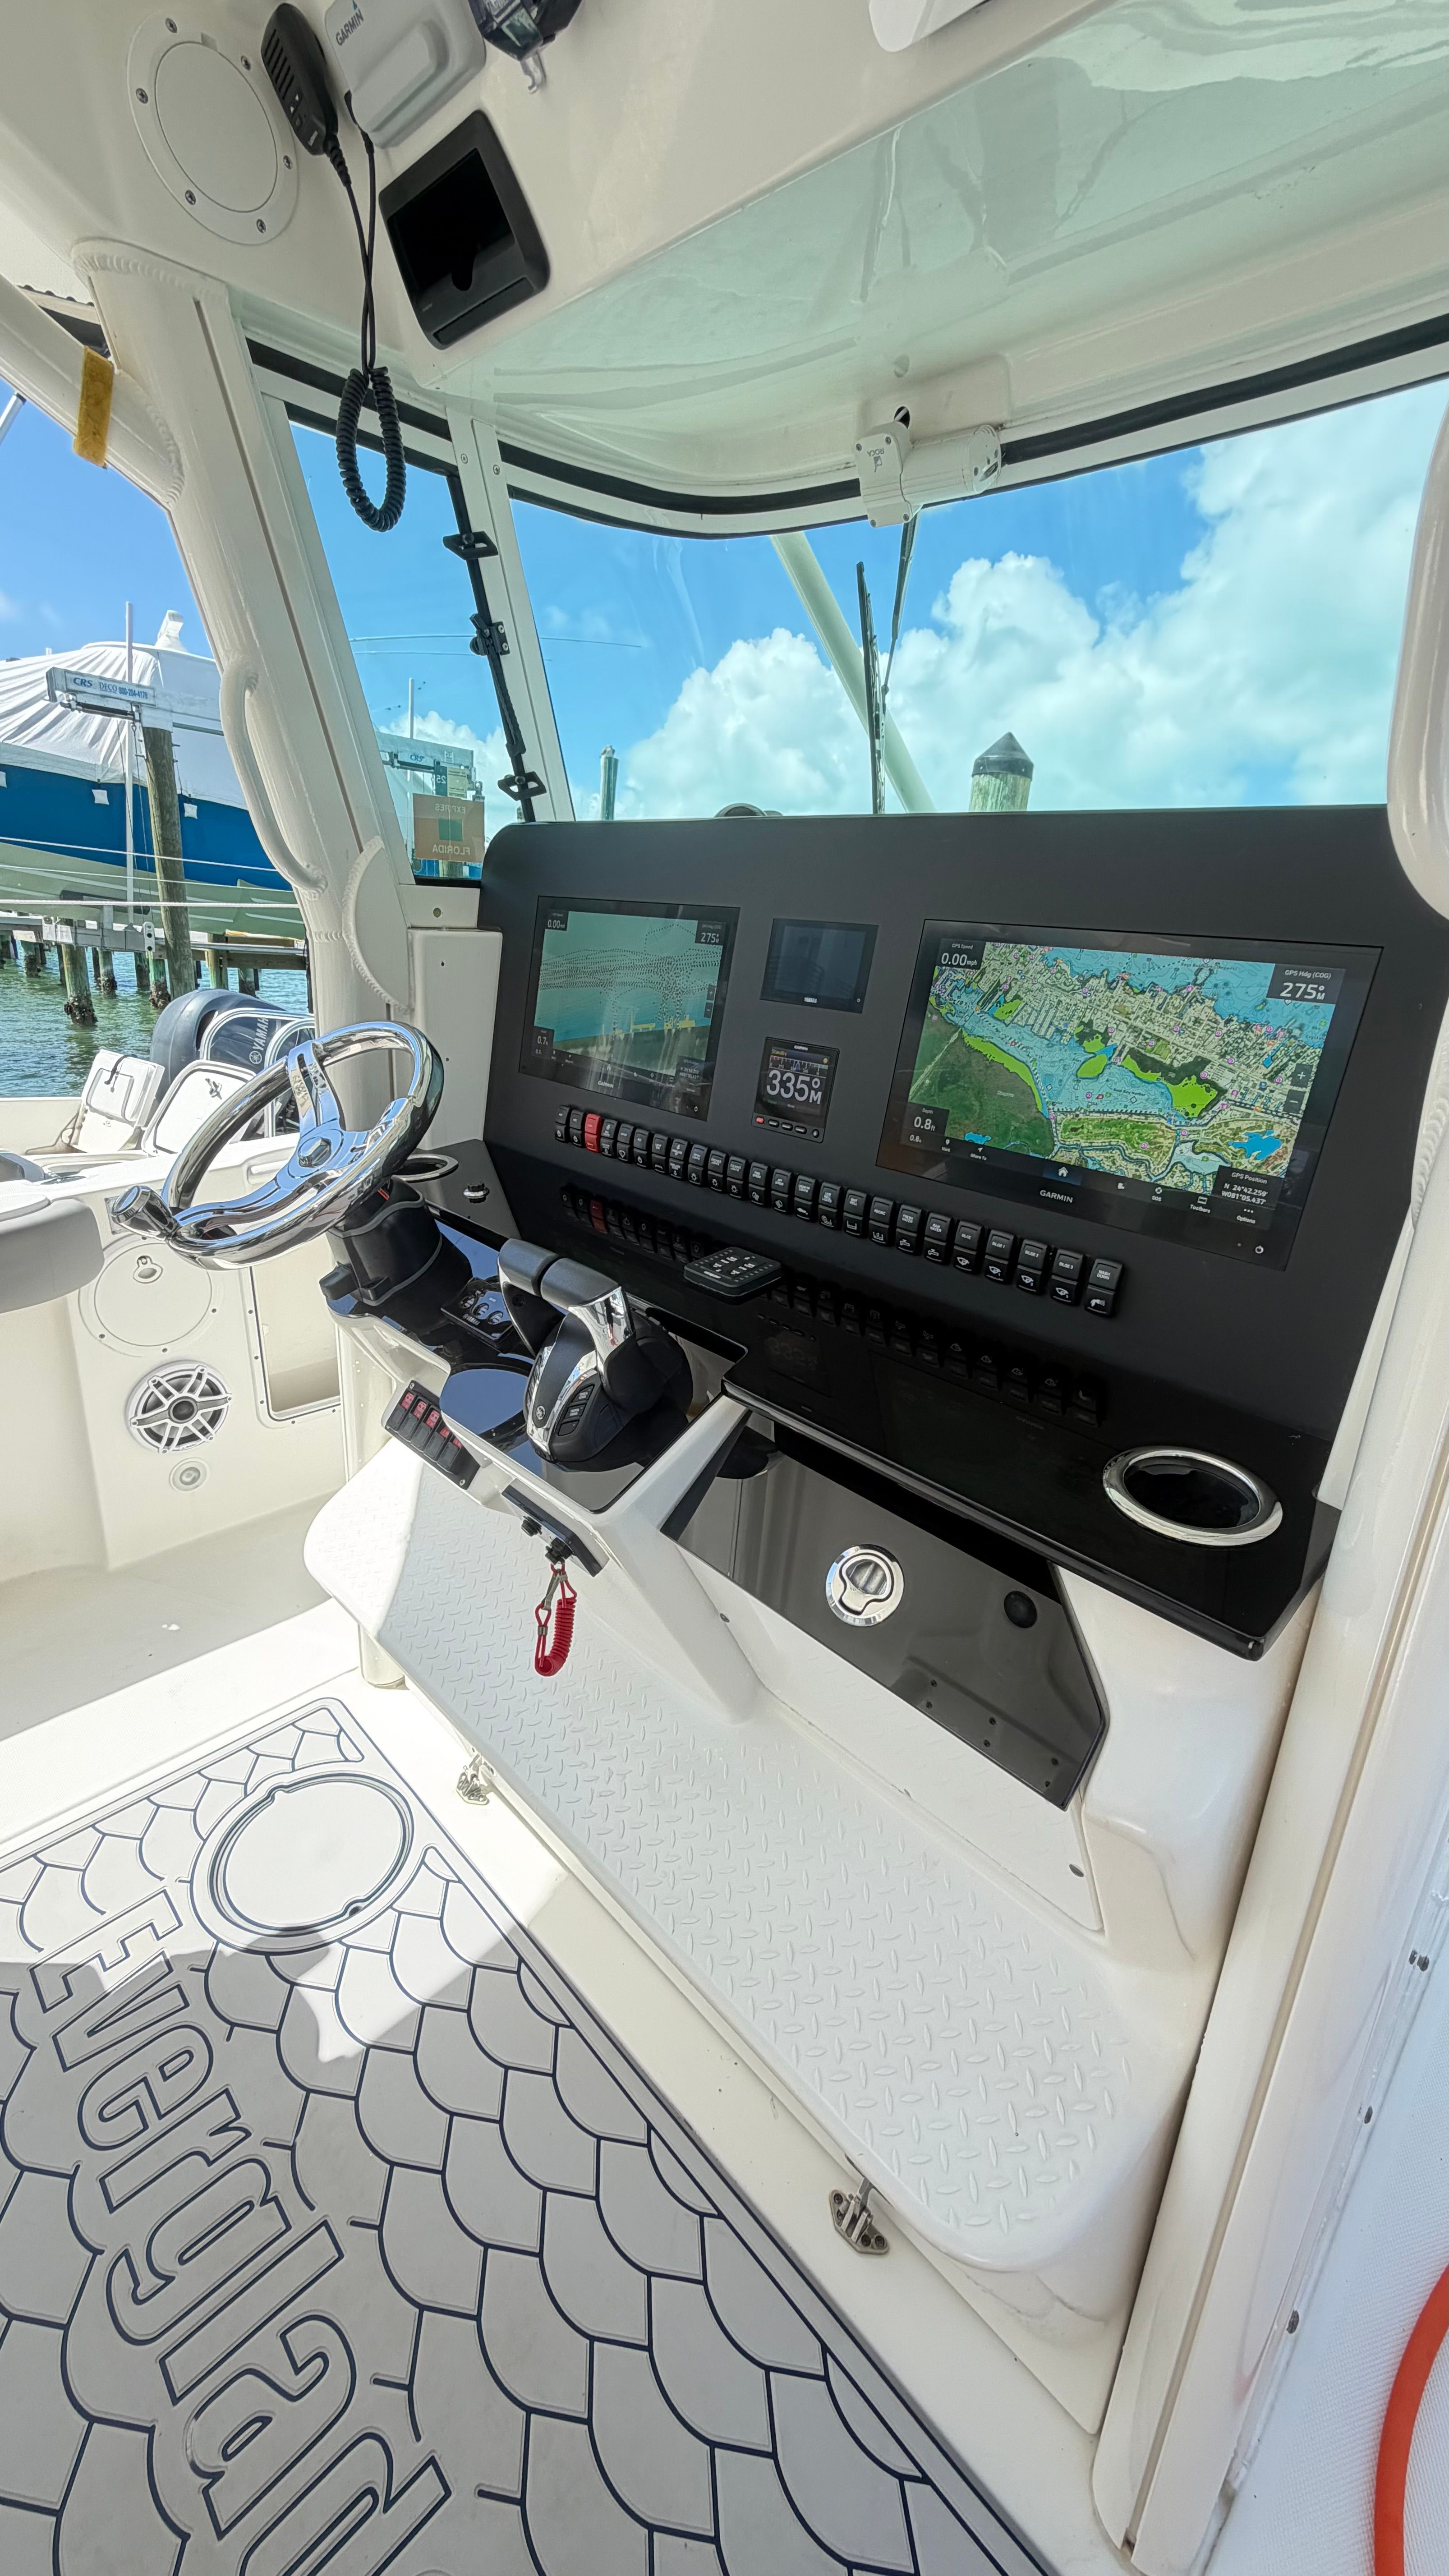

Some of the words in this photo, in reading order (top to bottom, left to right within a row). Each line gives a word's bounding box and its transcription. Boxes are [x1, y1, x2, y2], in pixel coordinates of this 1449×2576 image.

[336, 8, 364, 46] GARMIN
[867, 447, 884, 457] ROCA
[73, 677, 93, 687] CRS
[99, 682, 117, 691] DECO
[1312, 972, 1331, 980] (COG)
[252, 1017, 269, 1051] YAMAH
[1244, 1174, 1268, 1184] Position
[1040, 1190, 1073, 1203] GARMIN
[1236, 1215, 1256, 1224] Options
